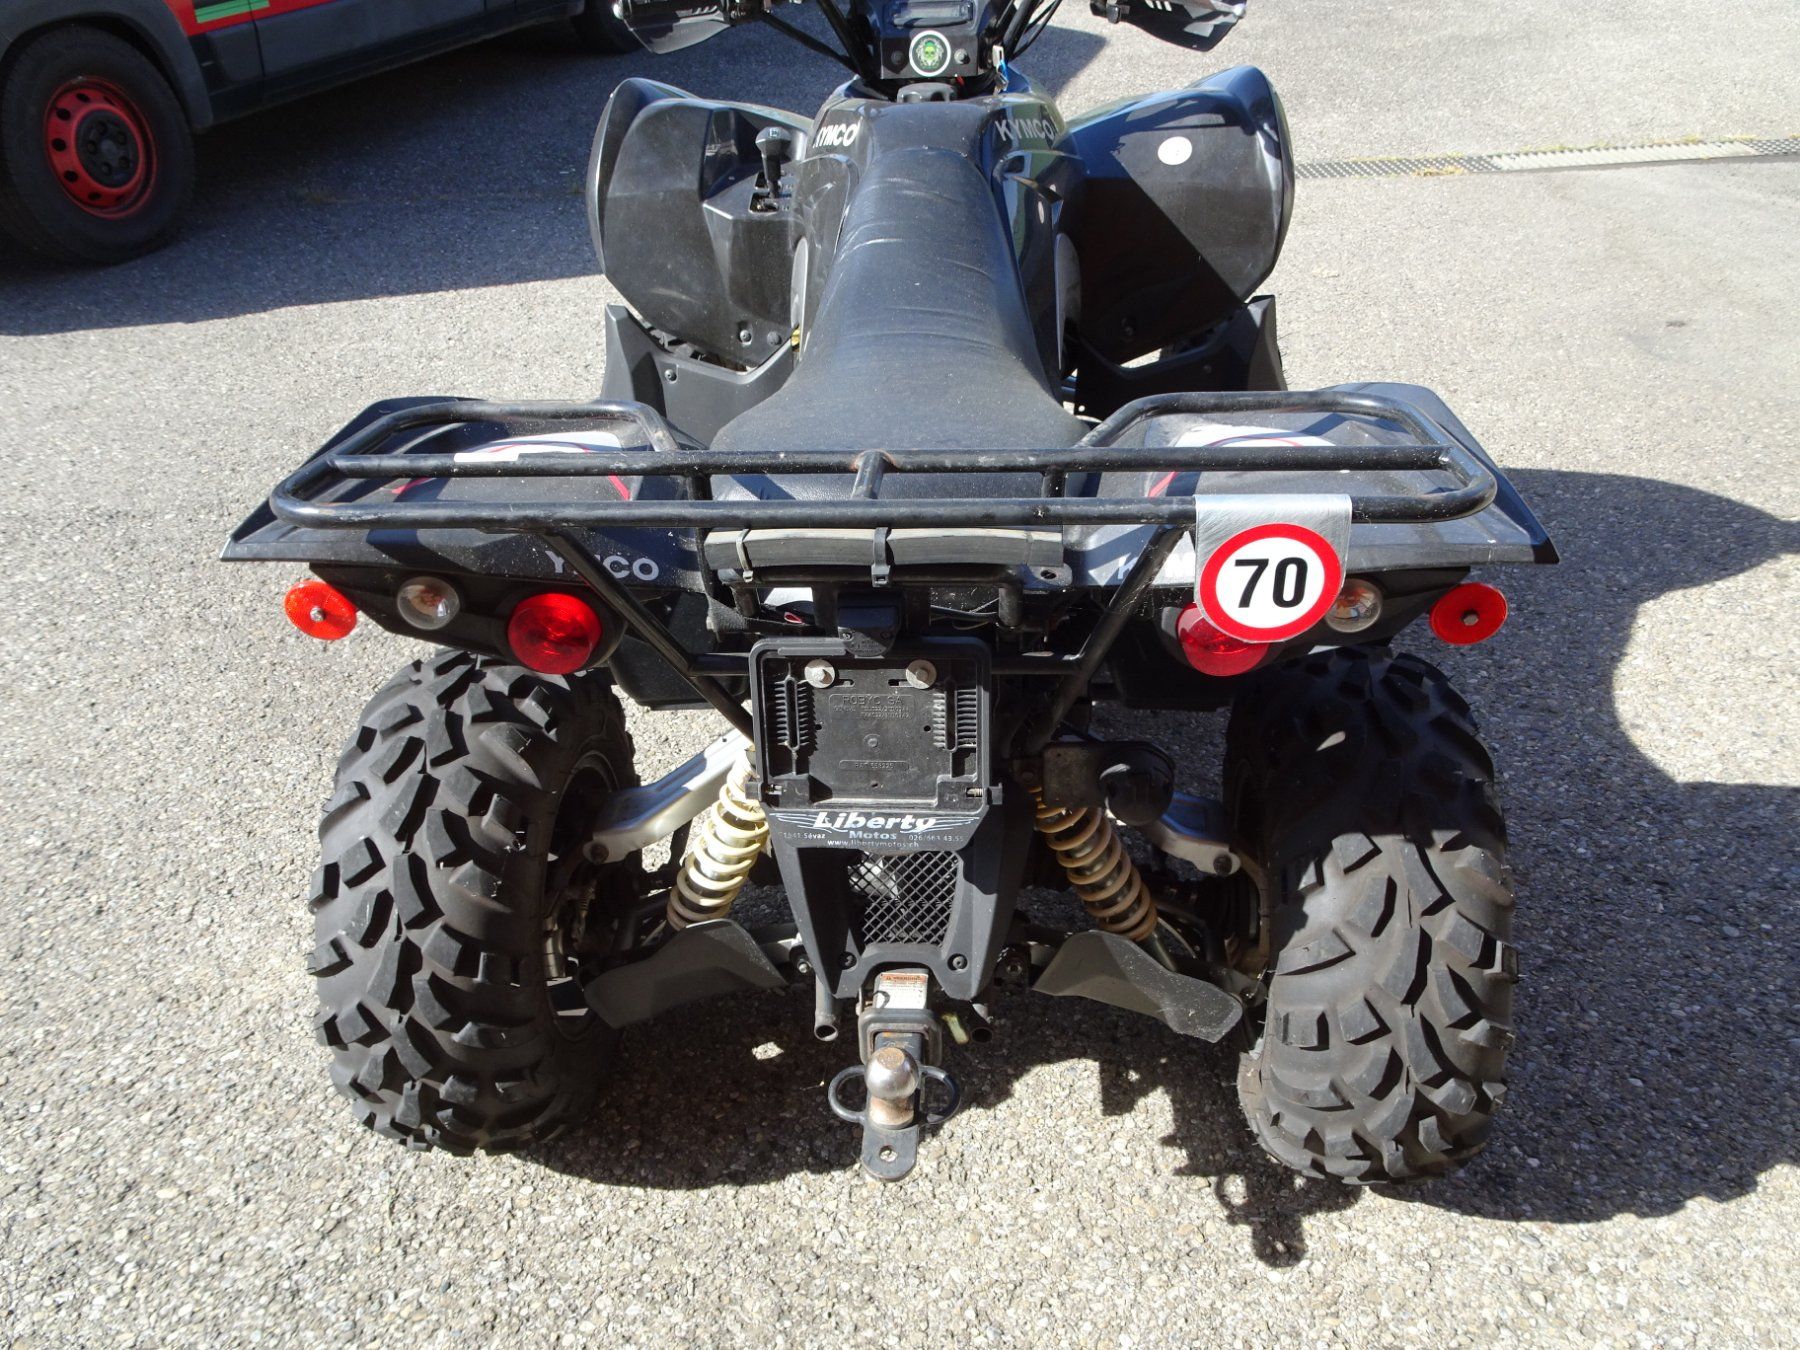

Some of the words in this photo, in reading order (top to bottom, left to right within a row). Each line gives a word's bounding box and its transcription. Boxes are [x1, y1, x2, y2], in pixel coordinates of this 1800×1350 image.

[995, 119, 1055, 141] KYMCO
[1234, 556, 1308, 608] 70
[812, 811, 937, 834] Liberty
[849, 831, 898, 840] Motos
